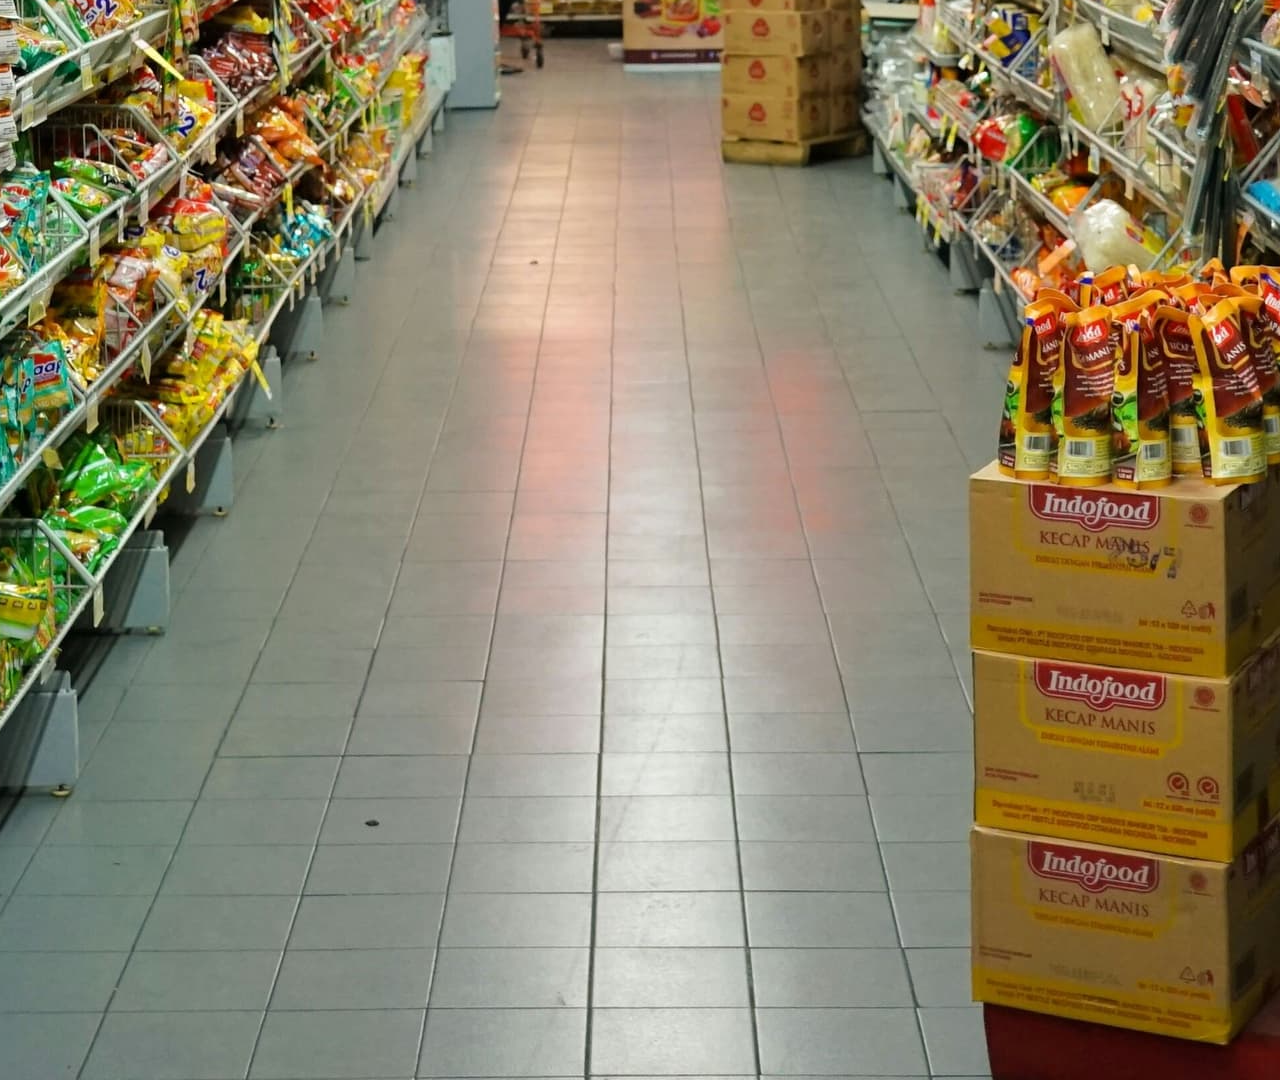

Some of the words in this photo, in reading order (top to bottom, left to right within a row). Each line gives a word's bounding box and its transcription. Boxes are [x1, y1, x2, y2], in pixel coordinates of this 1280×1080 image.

[1042, 493, 1152, 525] Indofood
[1039, 530, 1091, 549] KECAP
[1095, 536, 1151, 555] MANIS
[1046, 670, 1157, 704] Indofood
[1045, 707, 1097, 726] KECAP
[1101, 718, 1156, 736] MANIS
[1040, 850, 1150, 887] Indofood
[1038, 887, 1091, 910] KECAP
[1094, 899, 1150, 918] MANIS
